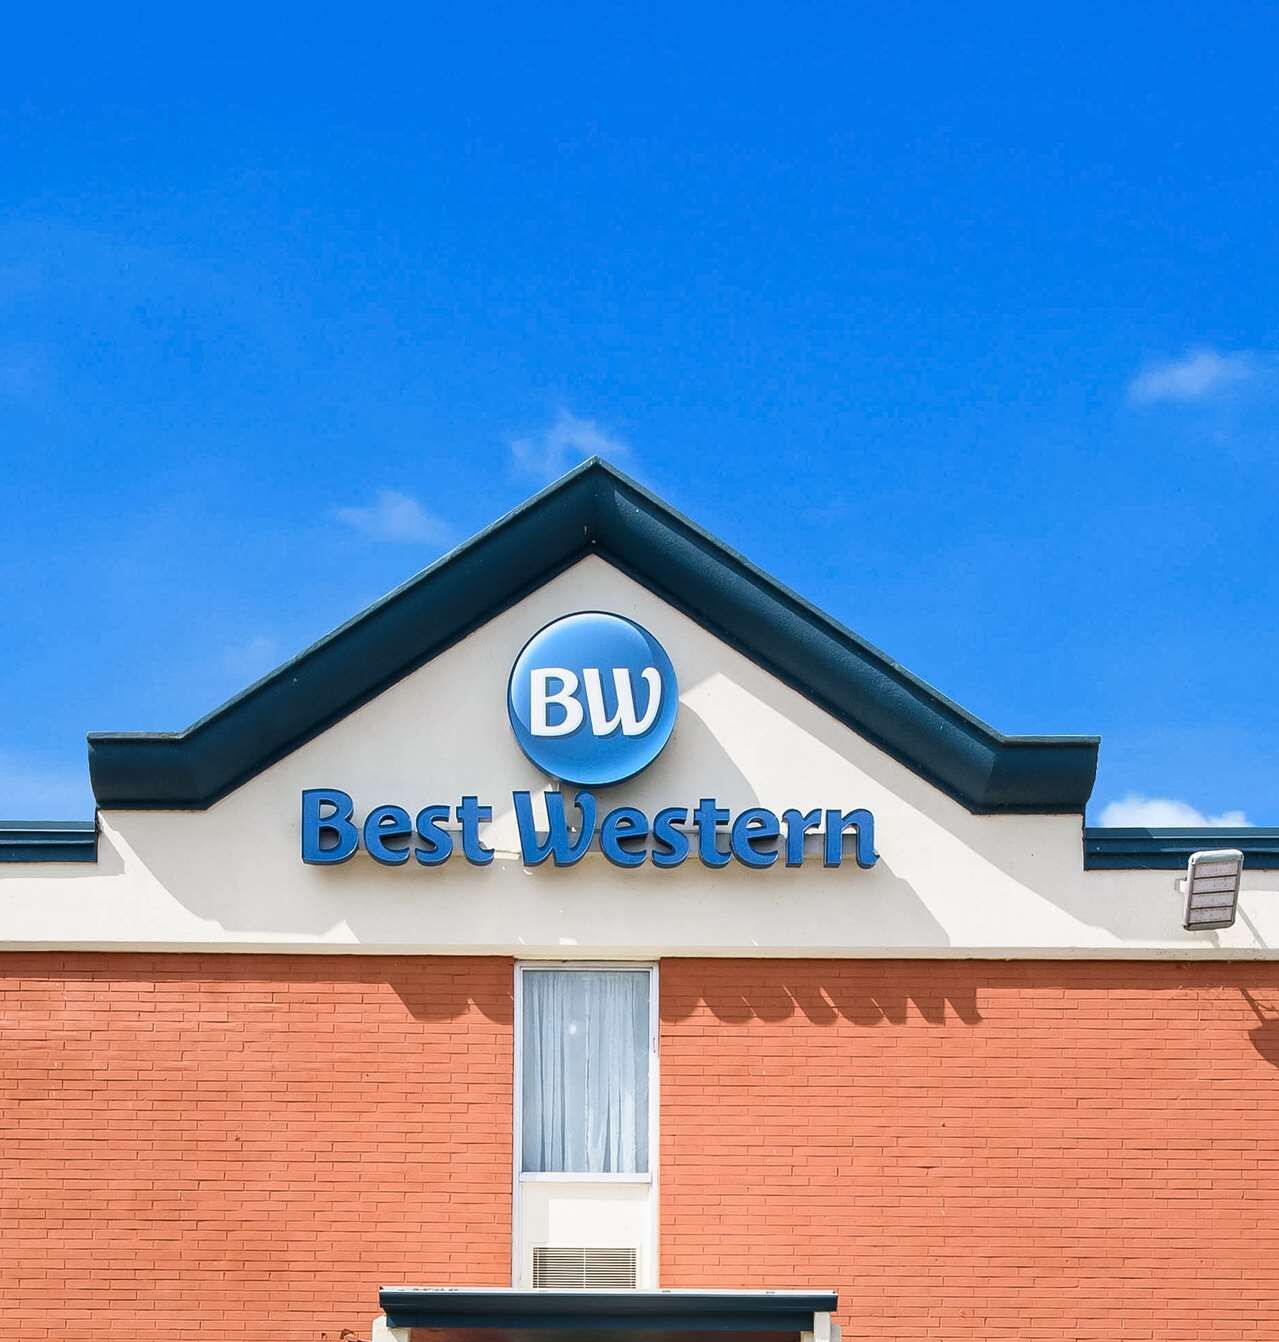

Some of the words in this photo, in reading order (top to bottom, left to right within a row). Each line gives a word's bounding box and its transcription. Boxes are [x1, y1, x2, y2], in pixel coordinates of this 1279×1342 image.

[530, 667, 663, 738] BW
[301, 788, 495, 867] Best
[512, 790, 879, 869] Western
